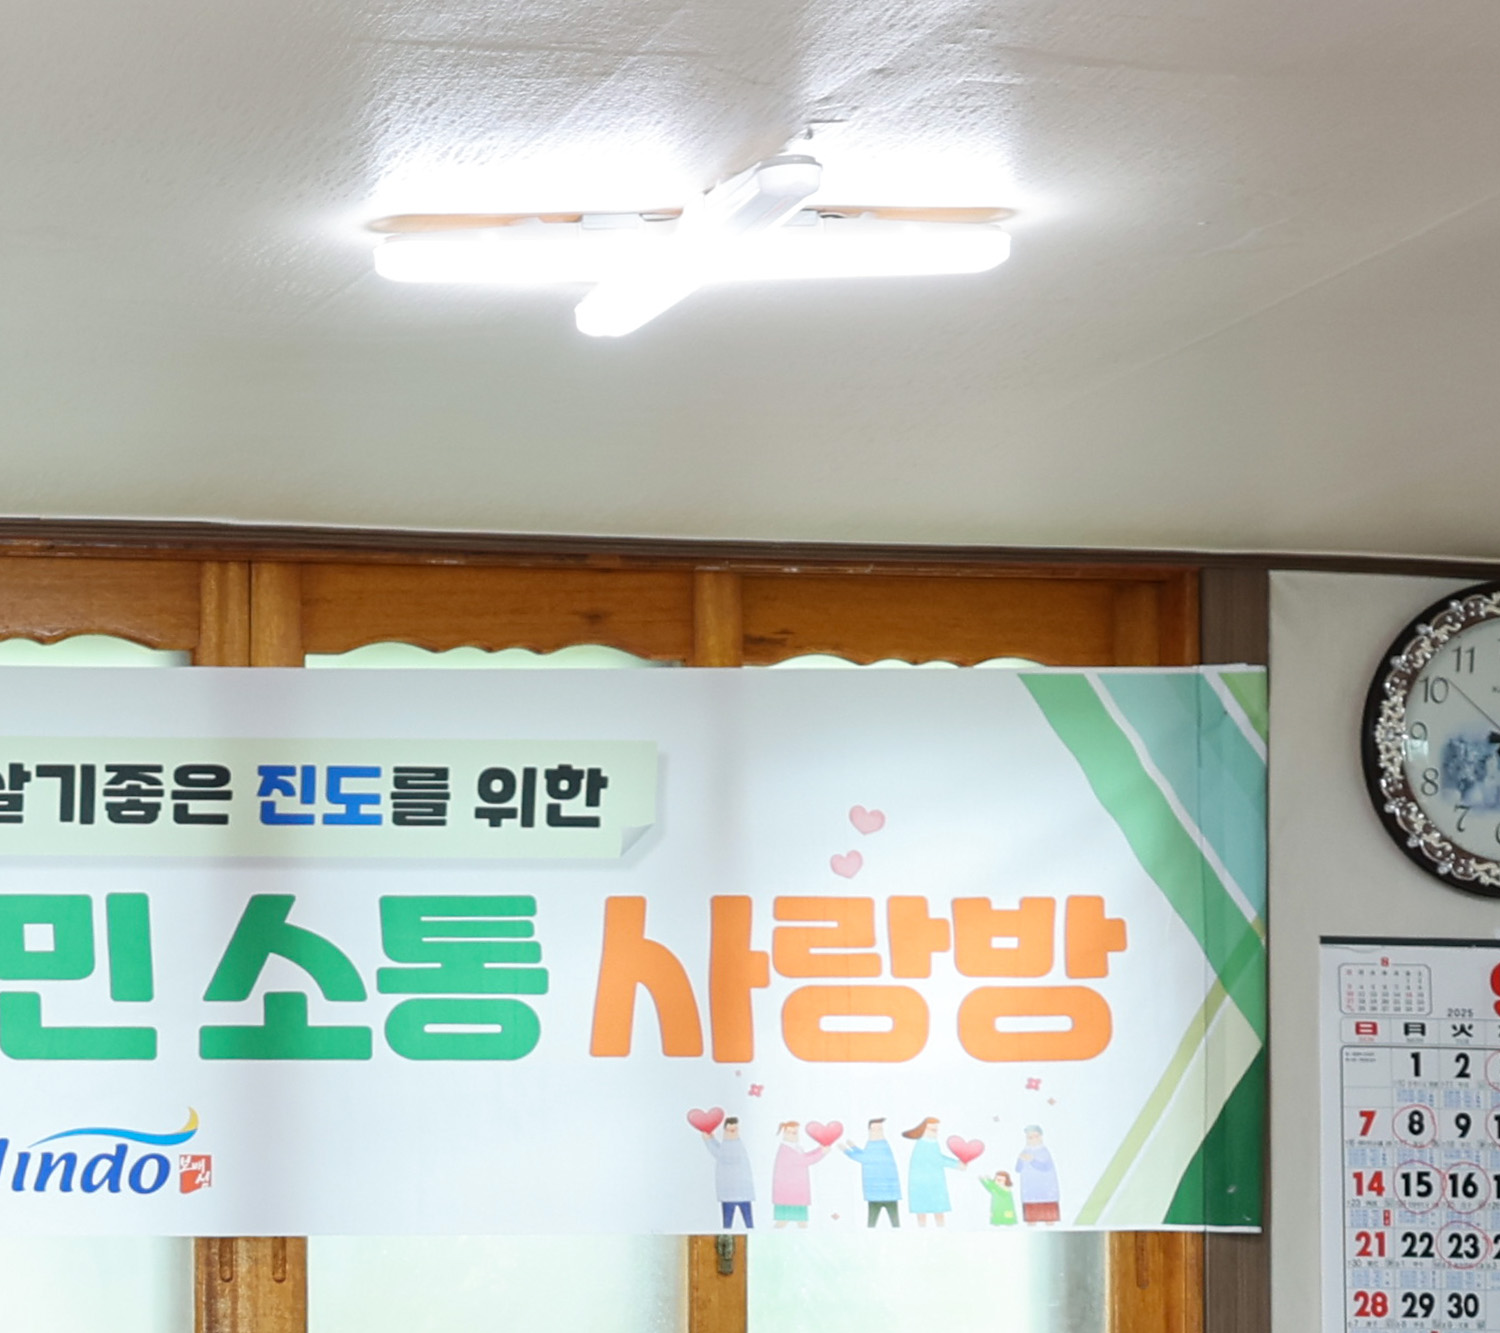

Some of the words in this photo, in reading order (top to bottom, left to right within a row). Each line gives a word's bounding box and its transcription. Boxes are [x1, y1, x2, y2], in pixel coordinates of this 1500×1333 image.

[1453, 646, 1476, 673] 11
[1420, 676, 1448, 703] 10
[1421, 767, 1439, 796] 8
[257, 765, 451, 827] 진도를
[474, 763, 609, 829] 위한
[1454, 805, 1471, 832] 7
[200, 895, 550, 1062] 소통
[592, 896, 1128, 1064] 사랑방
[1447, 1008, 1474, 1018] 2025
[1355, 1022, 1378, 1036] 日
[1403, 1022, 1426, 1036] 月
[1452, 1023, 1474, 1037] 火
[1412, 1053, 1421, 1077] 1
[1455, 1053, 1471, 1078] 2
[1359, 1110, 1376, 1136] 7
[1408, 1110, 1425, 1135] 8
[1455, 1113, 1471, 1138] 9
[1353, 1171, 1384, 1196] 14
[1401, 1172, 1433, 1198] 15
[1449, 1173, 1478, 1198] 16
[1355, 1232, 1385, 1256] 21
[1402, 1232, 1434, 1257] 22
[1448, 1233, 1480, 1259] 23
[1354, 1291, 1388, 1317] 28
[1402, 1292, 1434, 1318] 29
[1447, 1293, 1479, 1318] 30
